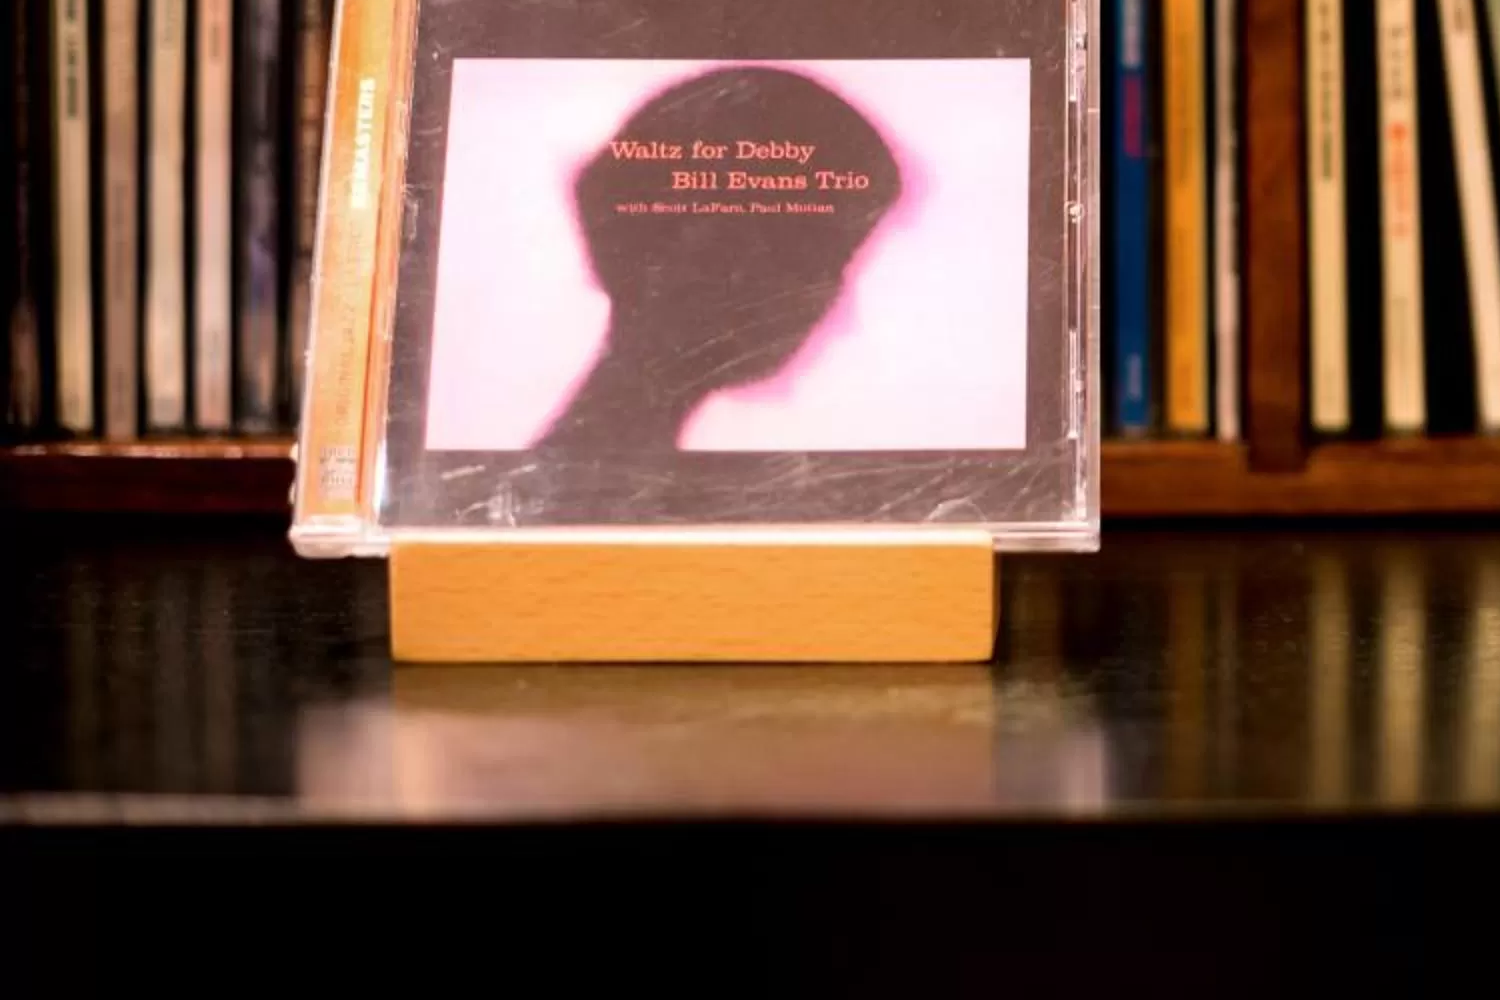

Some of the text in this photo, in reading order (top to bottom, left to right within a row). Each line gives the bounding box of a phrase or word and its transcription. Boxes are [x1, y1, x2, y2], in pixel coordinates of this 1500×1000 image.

[350, 77, 376, 209] MASTERS
[608, 140, 817, 164] Waltz for Debby
[671, 171, 869, 190] Bill Evans Trio
